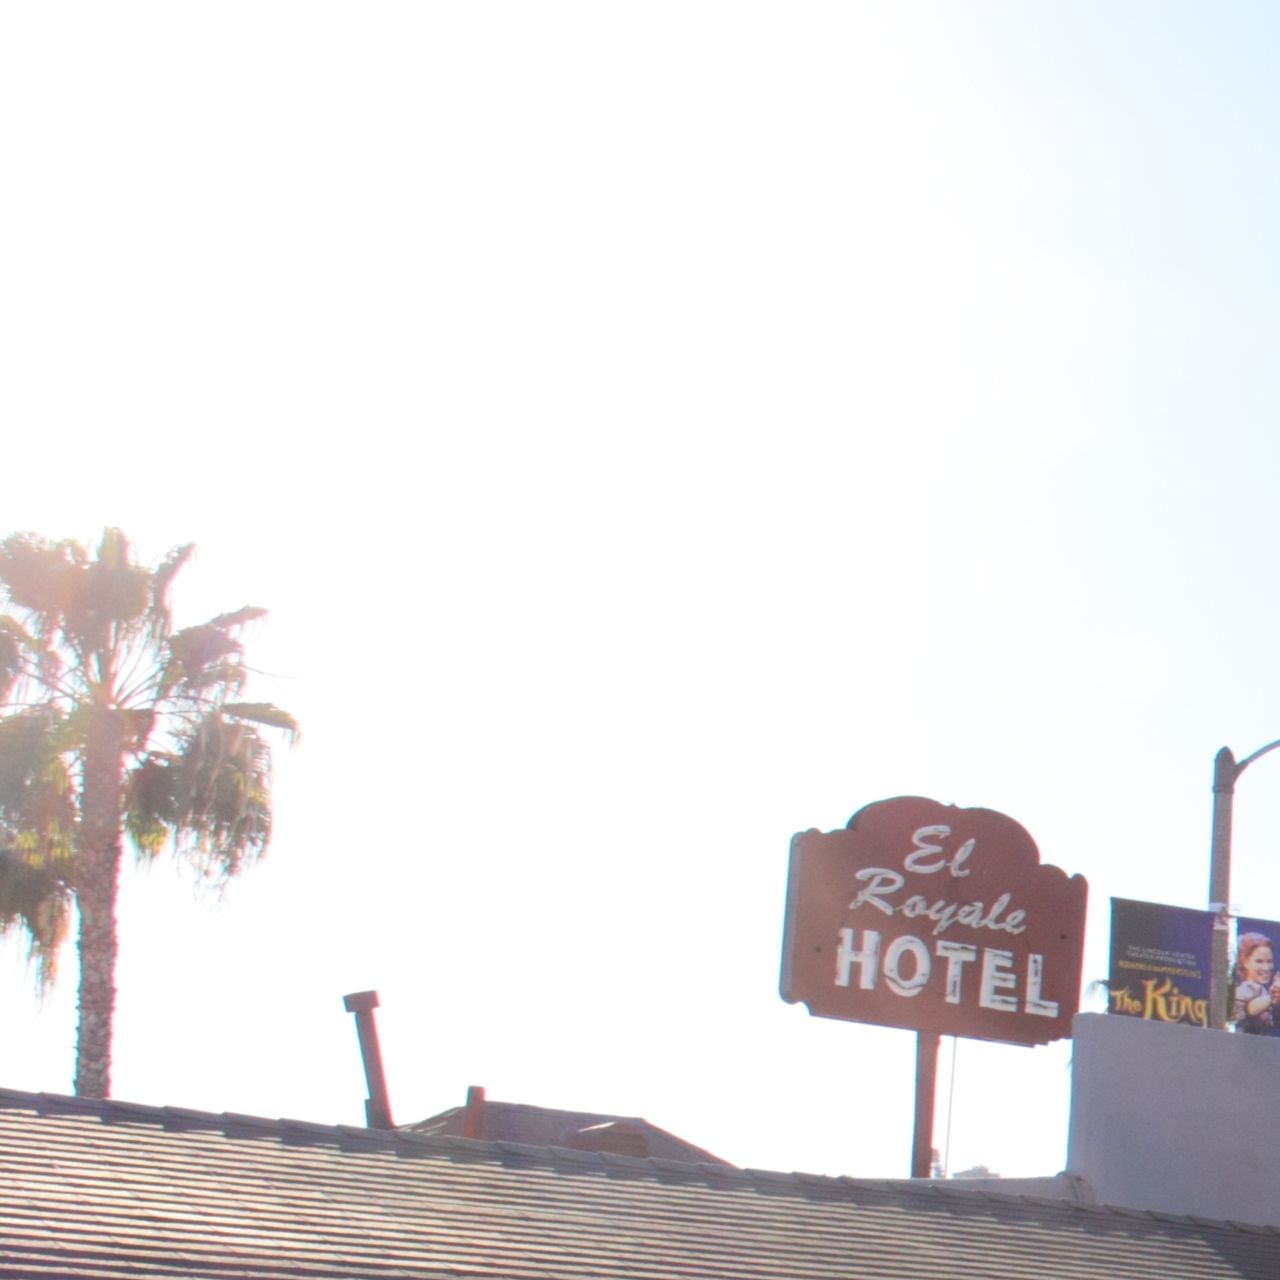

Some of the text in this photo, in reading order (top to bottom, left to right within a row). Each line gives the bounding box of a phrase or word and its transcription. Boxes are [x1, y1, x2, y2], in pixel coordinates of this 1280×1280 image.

[904, 825, 976, 878] El
[849, 867, 1026, 935] Royale
[834, 927, 1059, 1018] HOTEL
[1110, 976, 1208, 1028] The King
